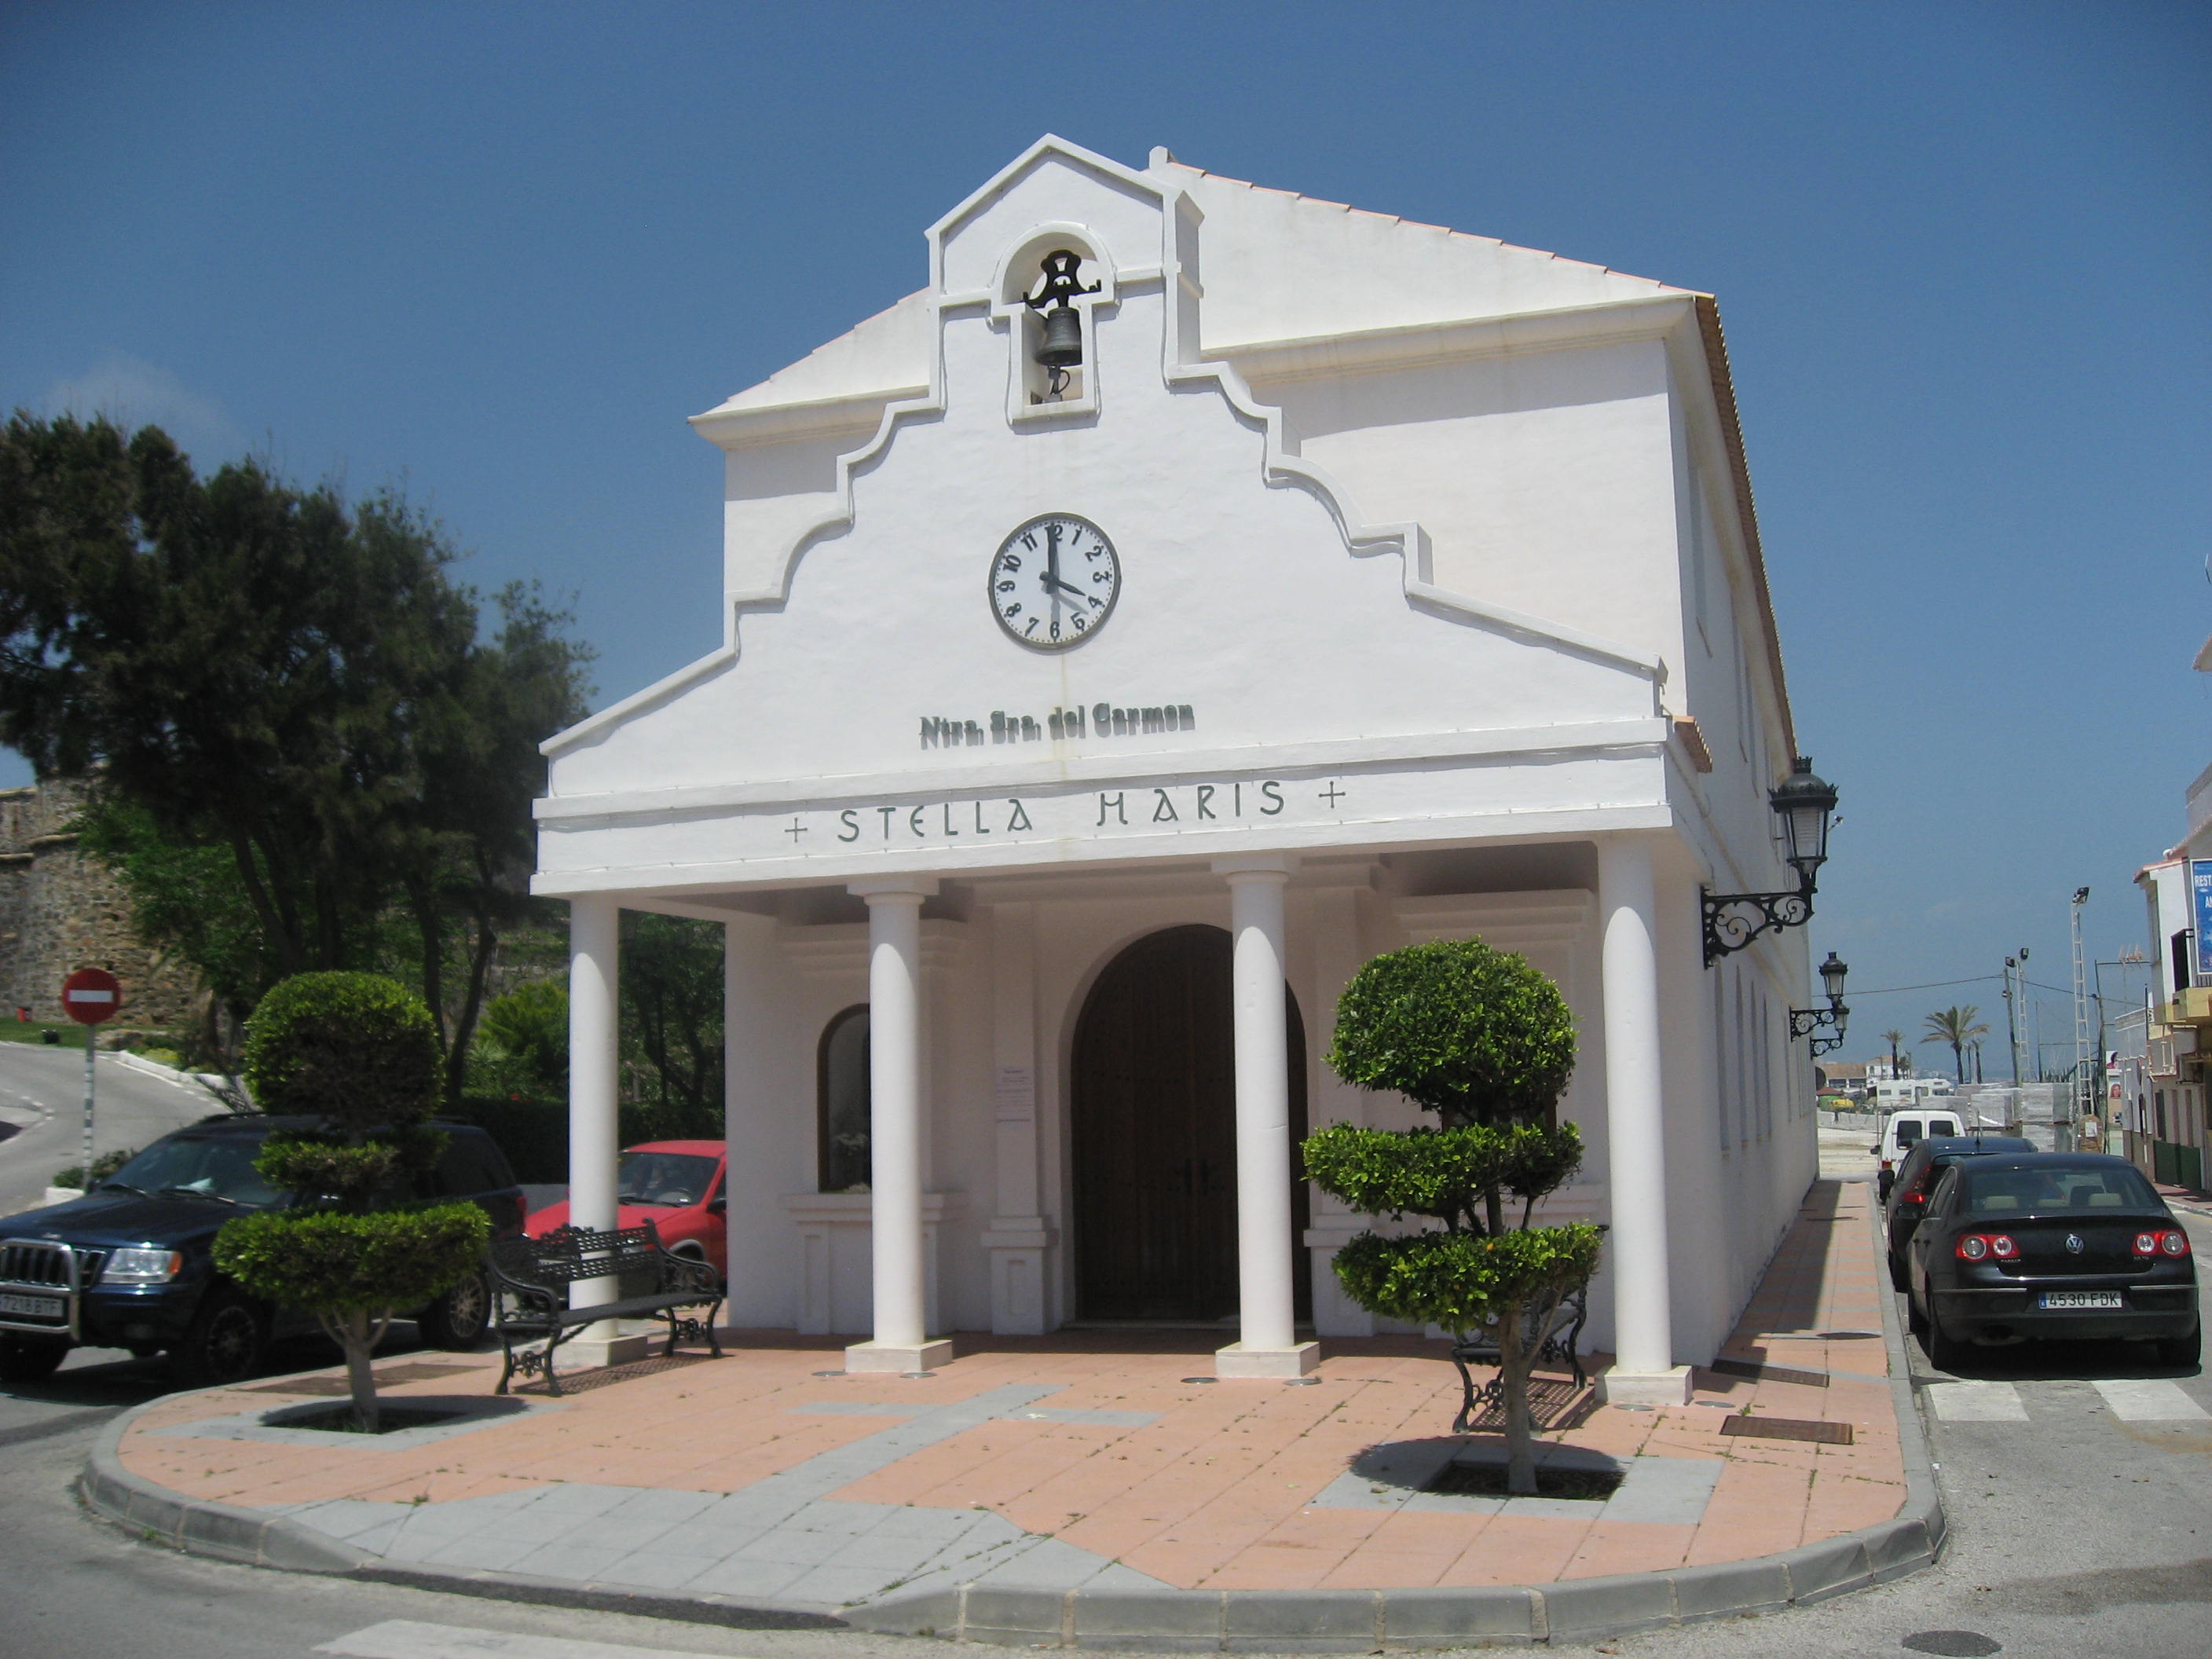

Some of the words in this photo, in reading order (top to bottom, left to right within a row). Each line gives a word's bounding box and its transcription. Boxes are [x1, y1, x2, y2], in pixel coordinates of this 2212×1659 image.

[1021, 532, 1038, 552] 11
[1071, 528, 1082, 546] 1
[1085, 545, 1103, 562] 2
[1003, 554, 1021, 573] 10
[997, 580, 1016, 592] 9
[1093, 571, 1110, 583] 3
[1006, 602, 1021, 617] 8
[1088, 595, 1102, 609] 4
[1024, 617, 1039, 637] 7
[1049, 621, 1060, 639] 6
[1070, 612, 1086, 631] 5
[1047, 705, 1086, 738] del
[1092, 703, 1195, 735] Carmen
[837, 798, 1033, 844] STELLA
[1097, 781, 1285, 827] MARIS
[2049, 1293, 2086, 1307] 4530
[2090, 1292, 2119, 1306] FDK
